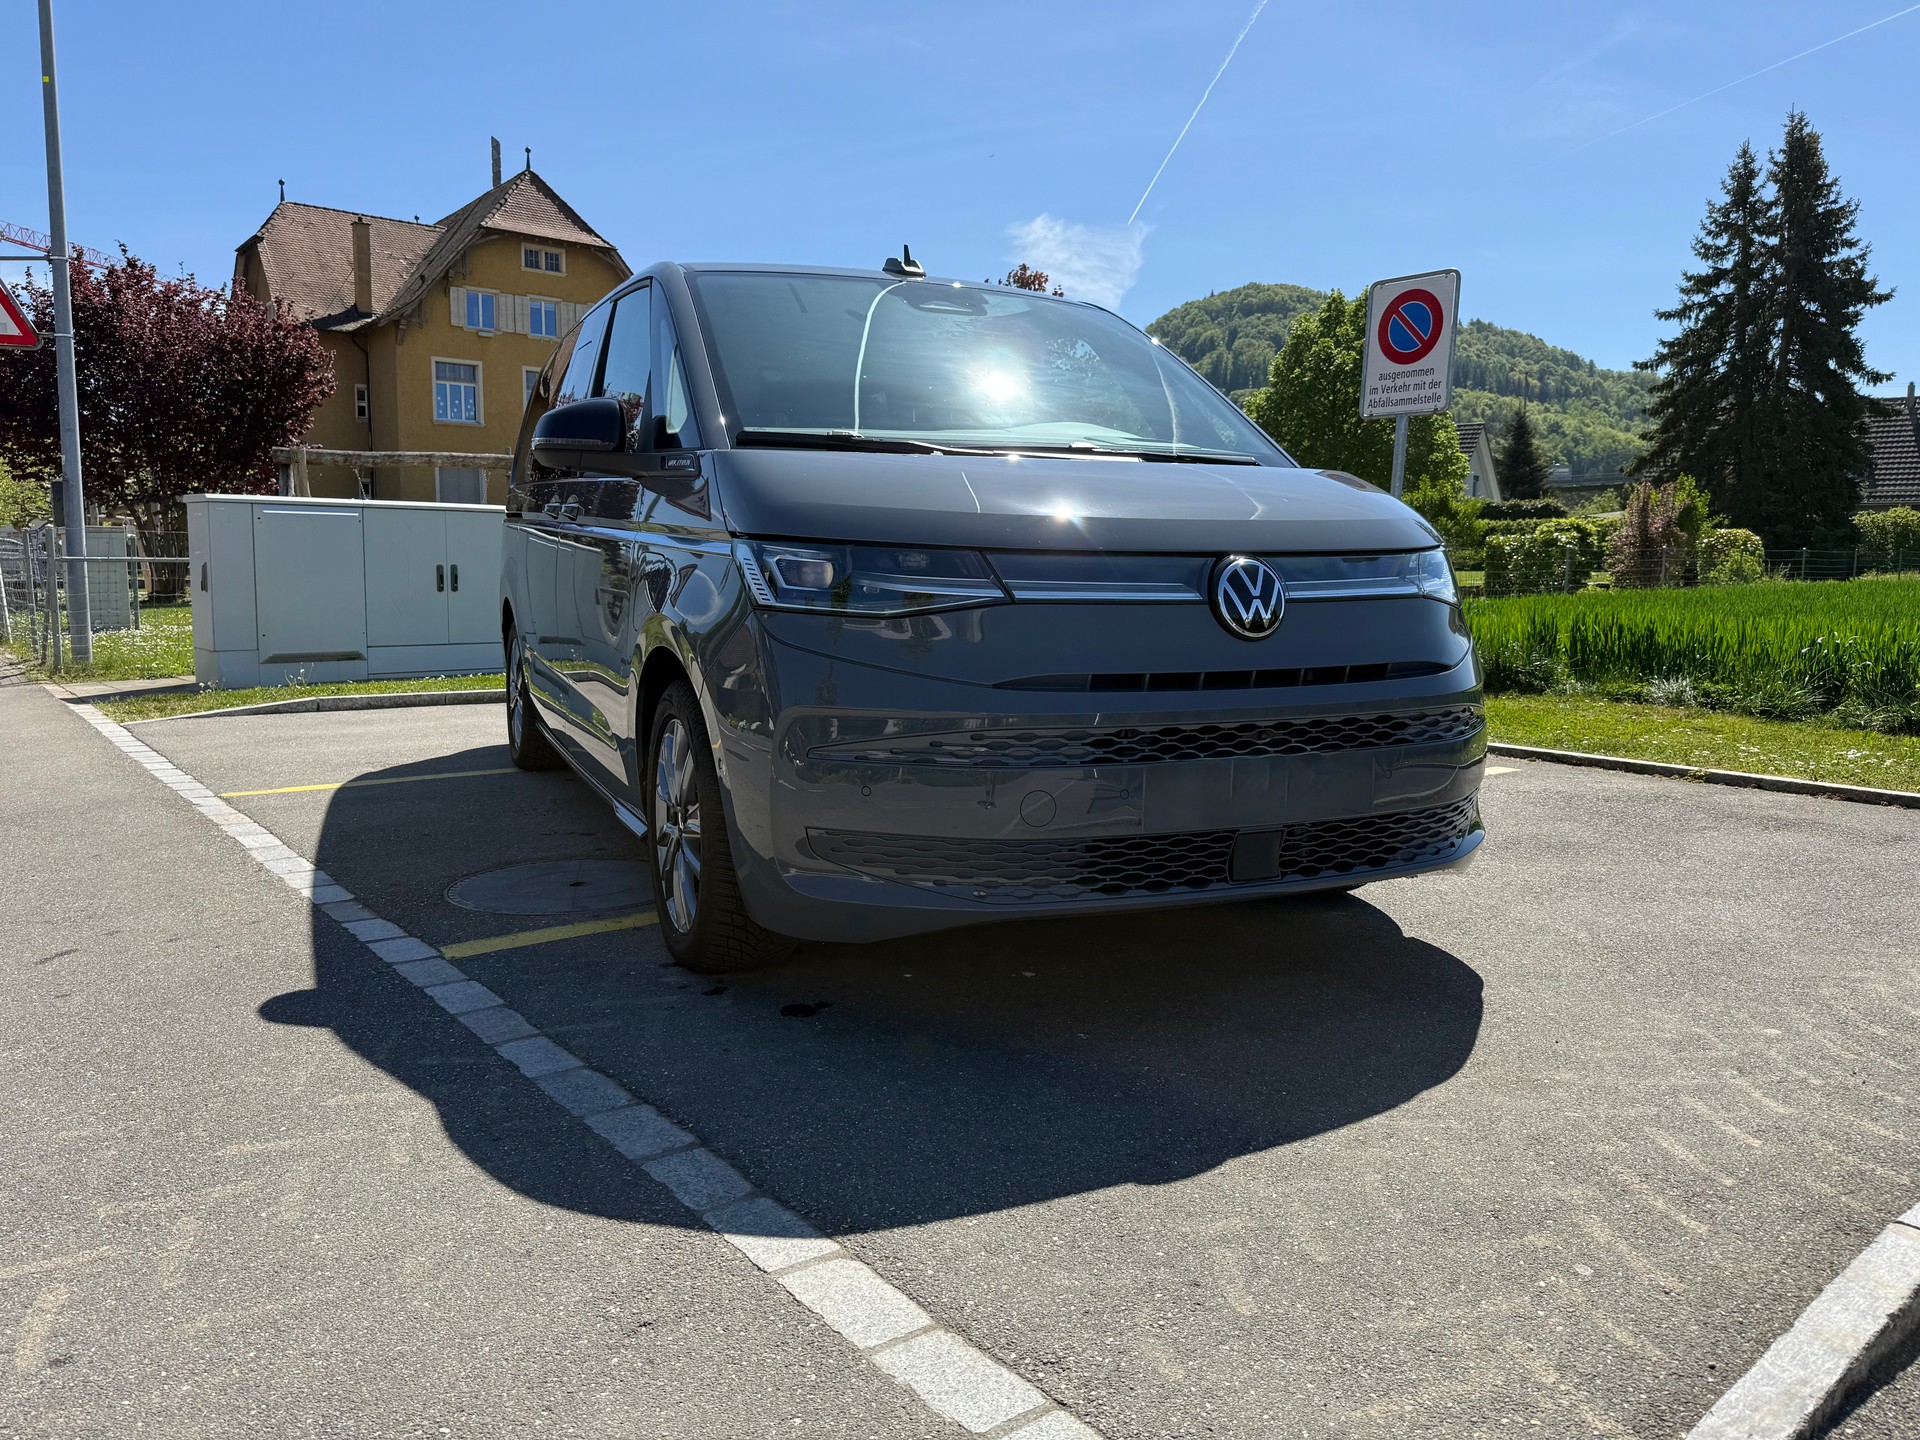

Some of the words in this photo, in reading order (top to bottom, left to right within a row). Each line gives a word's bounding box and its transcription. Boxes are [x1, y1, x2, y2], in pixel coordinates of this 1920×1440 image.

[1378, 367, 1435, 382] ausgenommen
[1369, 386, 1379, 396] im
[1381, 381, 1411, 394] Verkehr
[1412, 379, 1427, 391] mit
[1428, 379, 1442, 390] der
[1367, 392, 1442, 409] Abfallsammelstelle
[1220, 561, 1282, 632] VW
